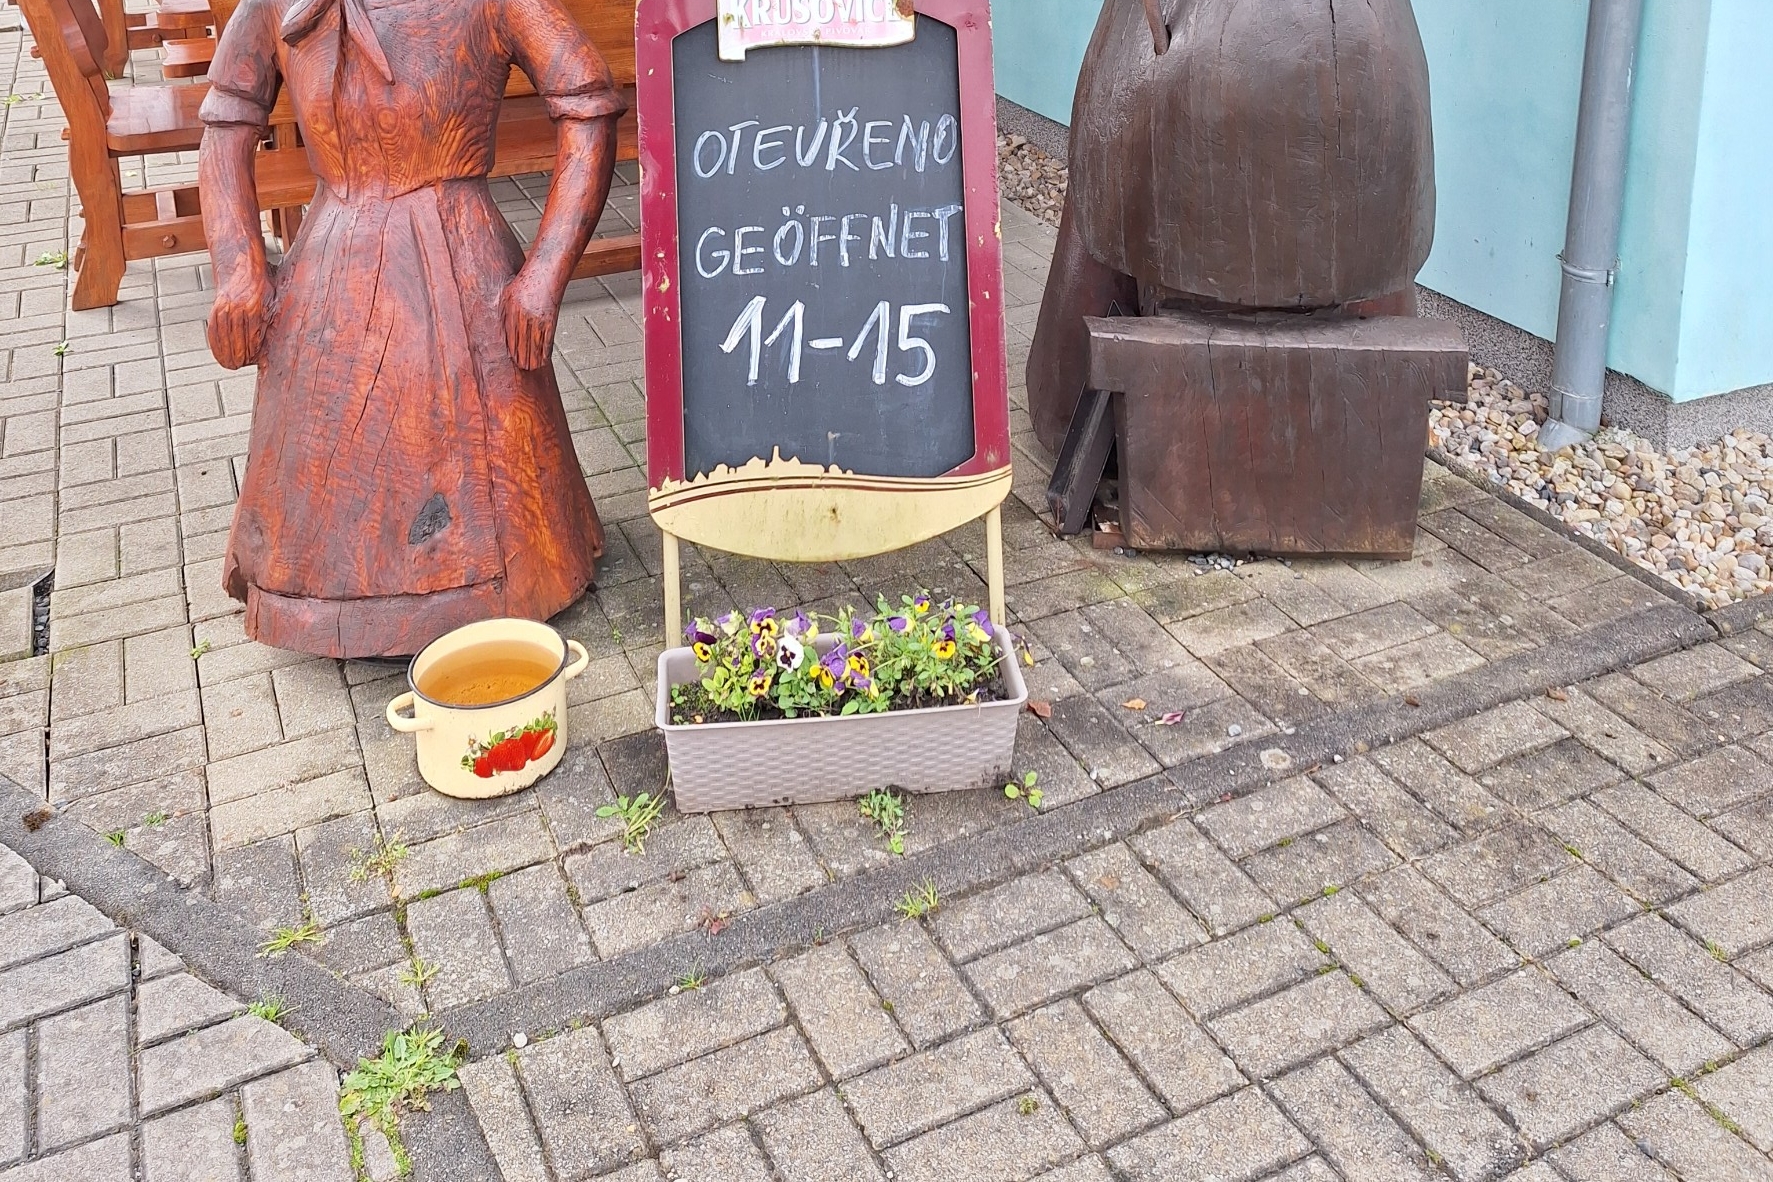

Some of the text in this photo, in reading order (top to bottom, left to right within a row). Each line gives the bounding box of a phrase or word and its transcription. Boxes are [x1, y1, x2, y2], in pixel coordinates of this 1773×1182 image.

[693, 107, 958, 178] OTEVŘENO
[695, 203, 963, 278] GEÖFFNET
[719, 295, 950, 387] 11-15
